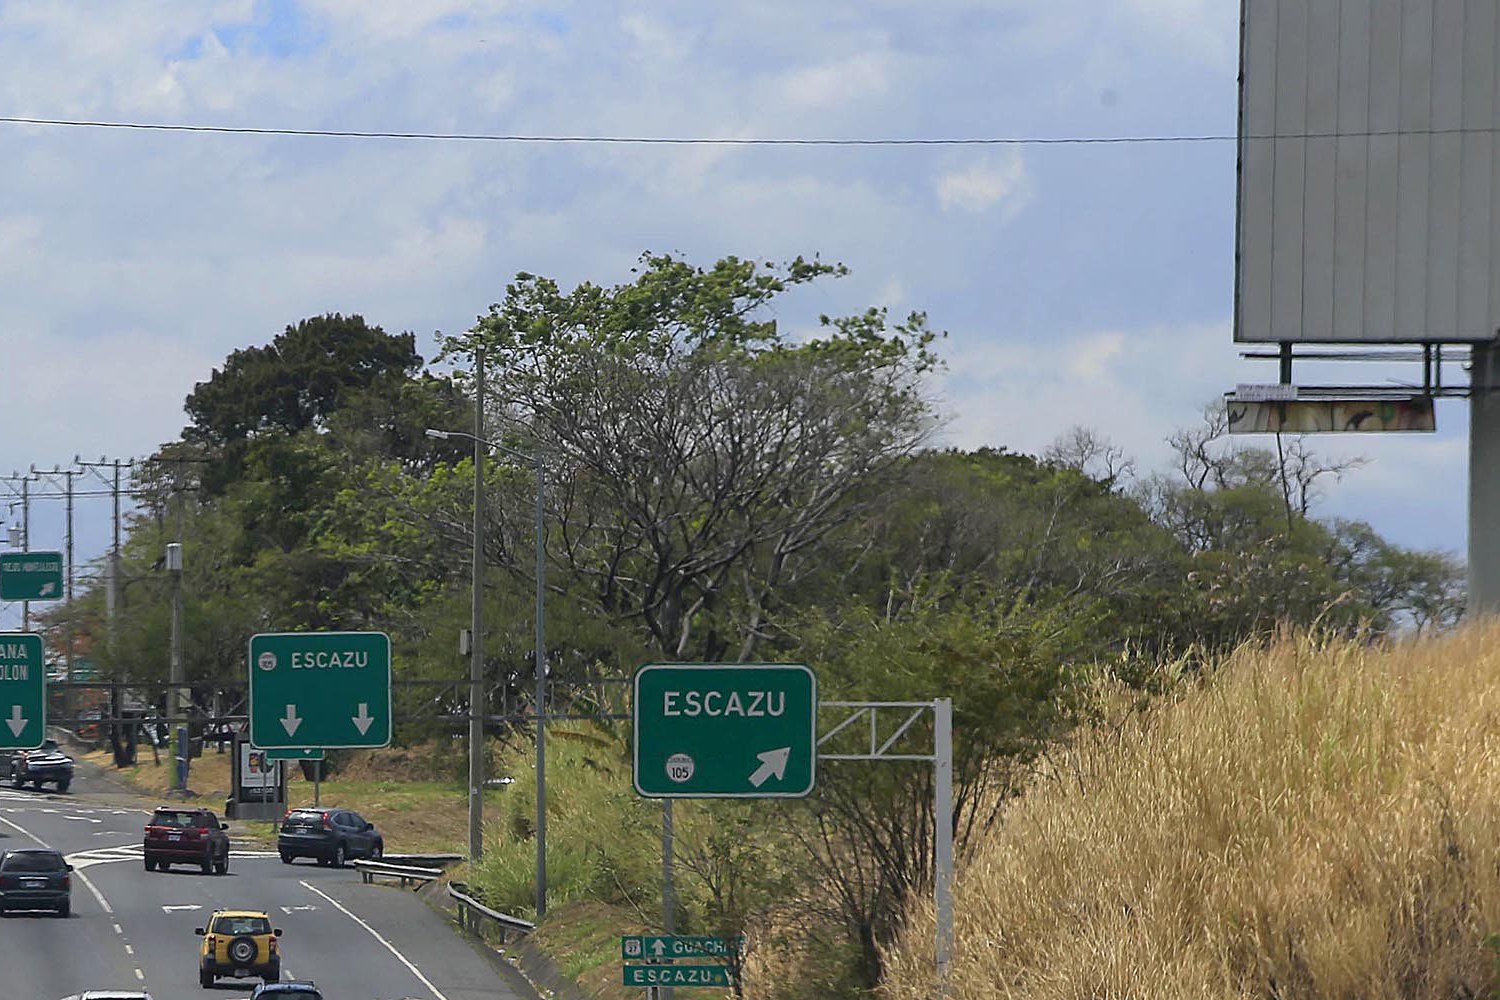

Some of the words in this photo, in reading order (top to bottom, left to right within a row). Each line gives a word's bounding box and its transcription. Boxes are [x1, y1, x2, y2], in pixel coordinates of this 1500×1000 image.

[291, 652, 368, 668] ESCAZU
[664, 691, 785, 716] ESCAZU
[672, 767, 689, 779] 105
[633, 969, 711, 982] ESCAZU
